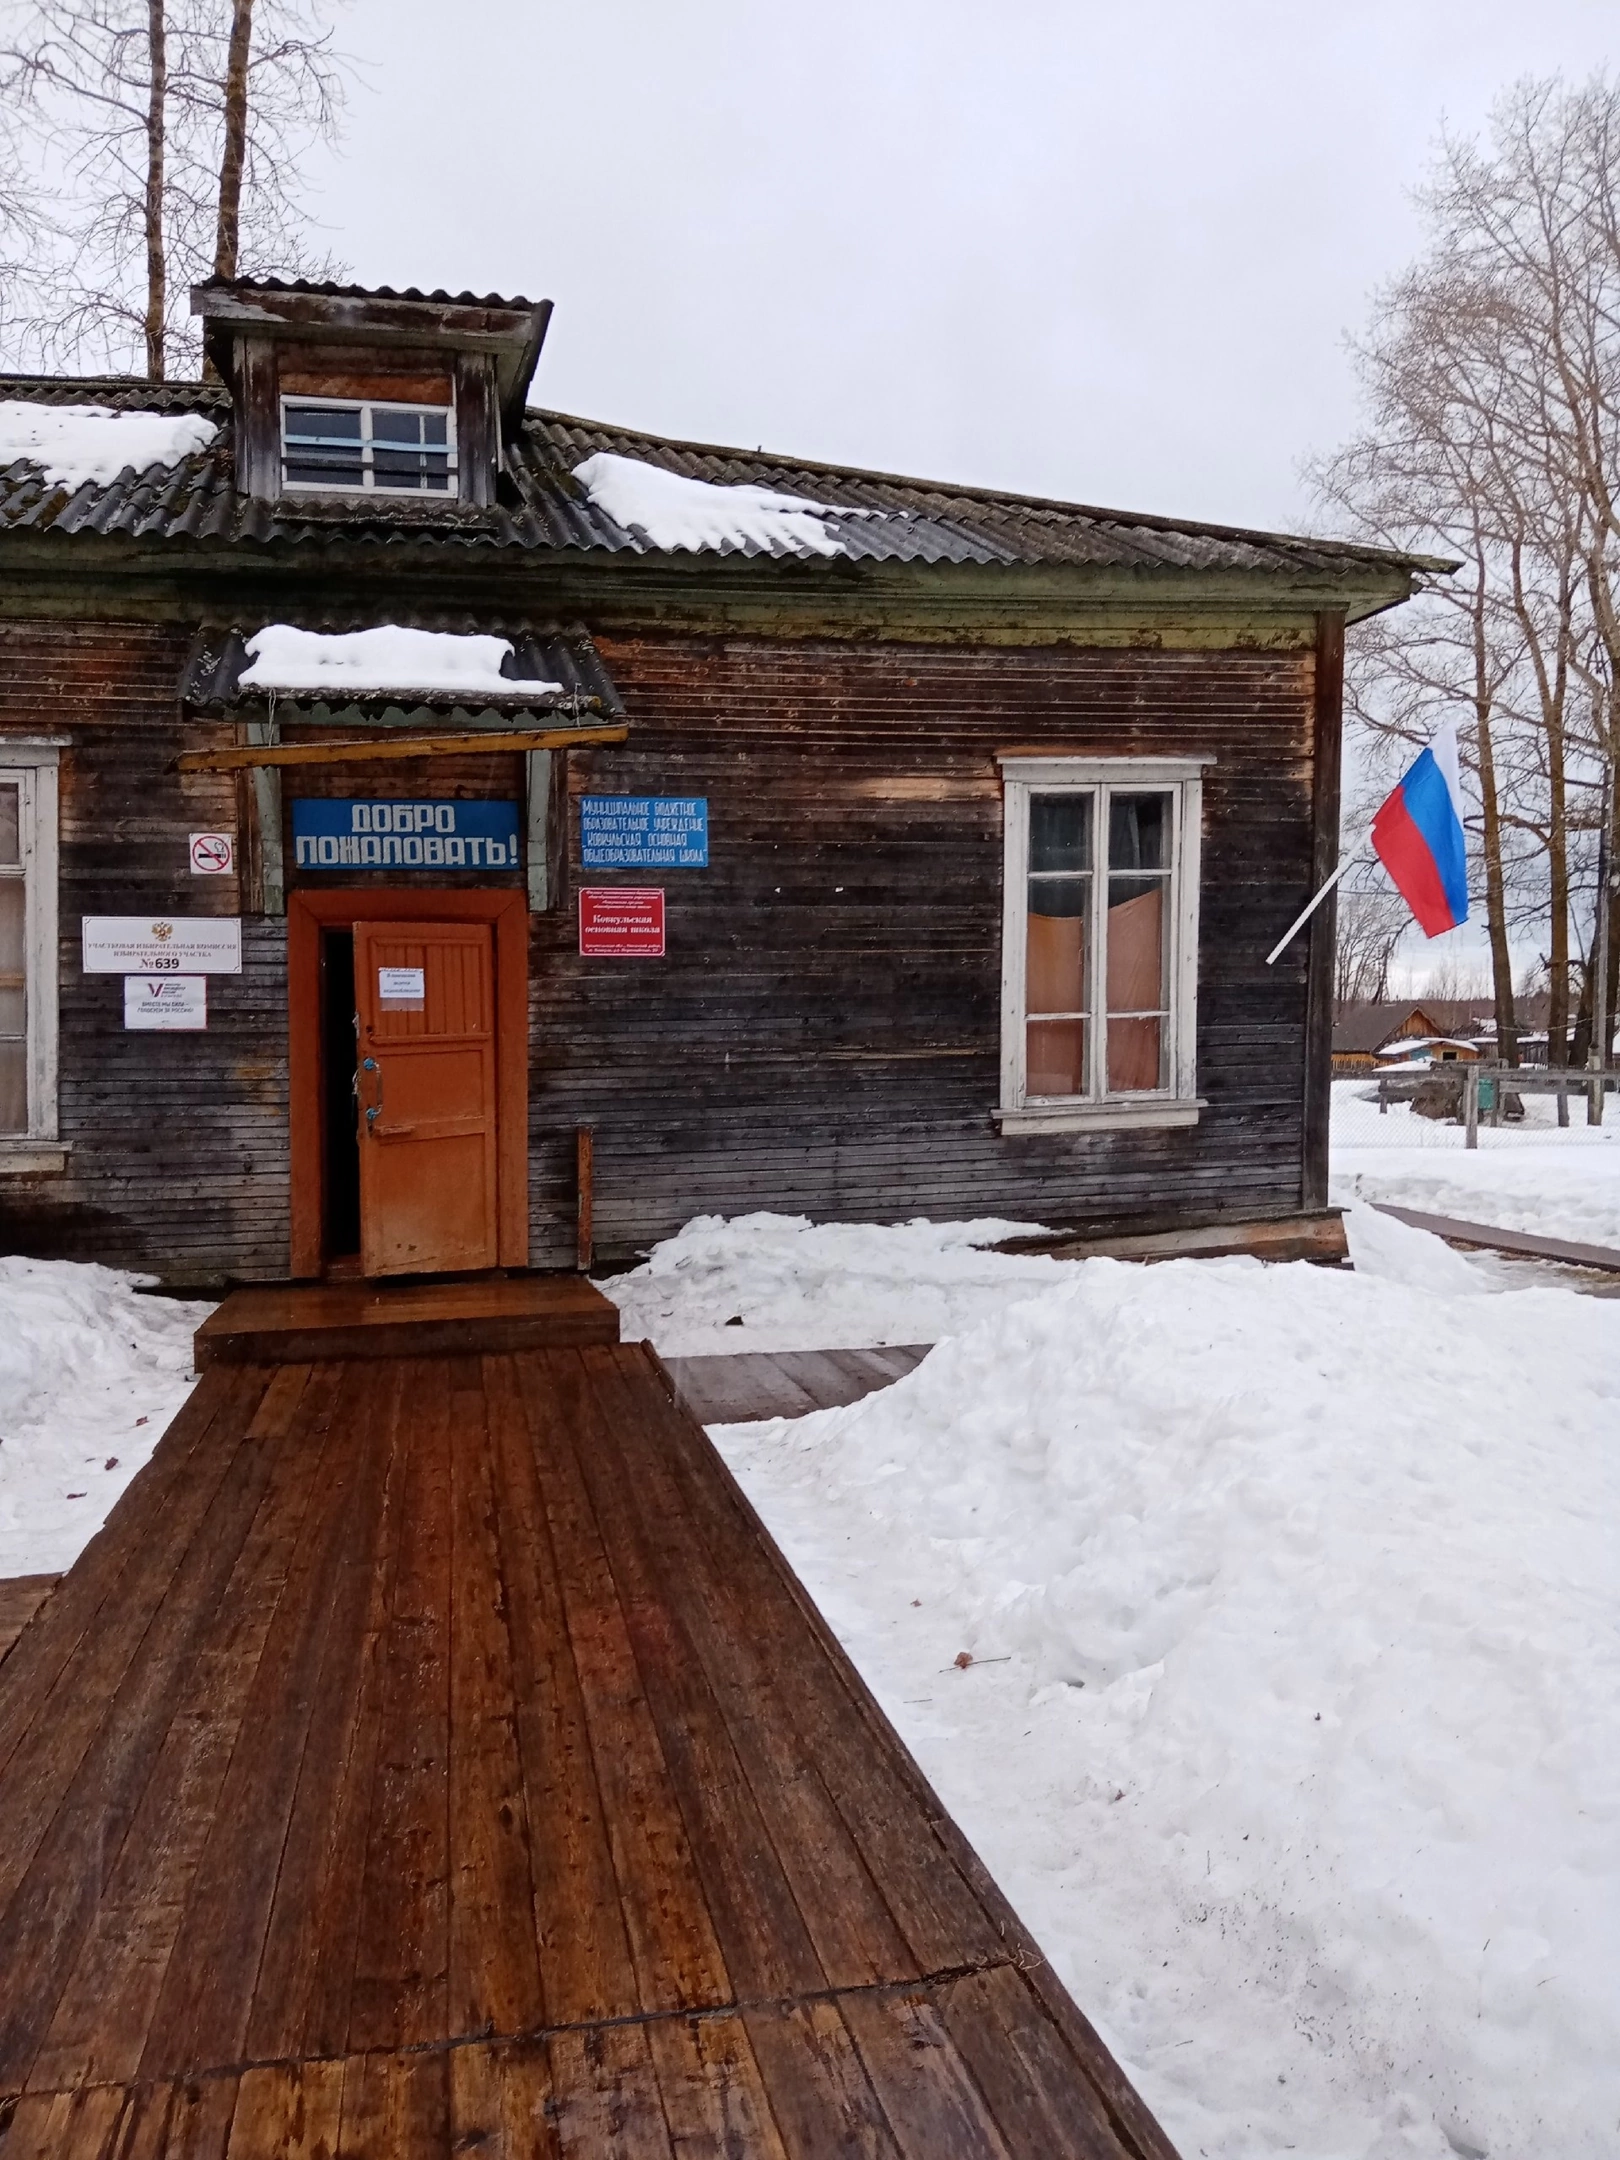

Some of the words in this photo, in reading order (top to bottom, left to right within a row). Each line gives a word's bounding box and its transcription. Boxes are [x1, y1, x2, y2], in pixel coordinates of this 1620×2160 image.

[654, 801, 697, 816] БЮДЖЕТНОЕ
[351, 804, 456, 833] ДОБРО
[583, 817, 650, 832] ОБРАЗОВАТЕЛЬНОЕ
[653, 817, 704, 832] УЧРЕЖДЕНИЕ
[647, 832, 688, 847] ОСНОВНАЯ
[295, 833, 518, 866] ПОЖАЛОВАТЬ!
[583, 848, 675, 863] ОБЩЕОБРАЗОВАТЕЛЬНАЯ
[584, 926, 628, 934] основная
[630, 926, 661, 934] школа
[88, 942, 135, 950] УЧАСТКОВАЯ
[196, 943, 237, 951] КОМИССИЯ
[113, 950, 177, 958] ИЗБИРАТЕЛЬНОГО
